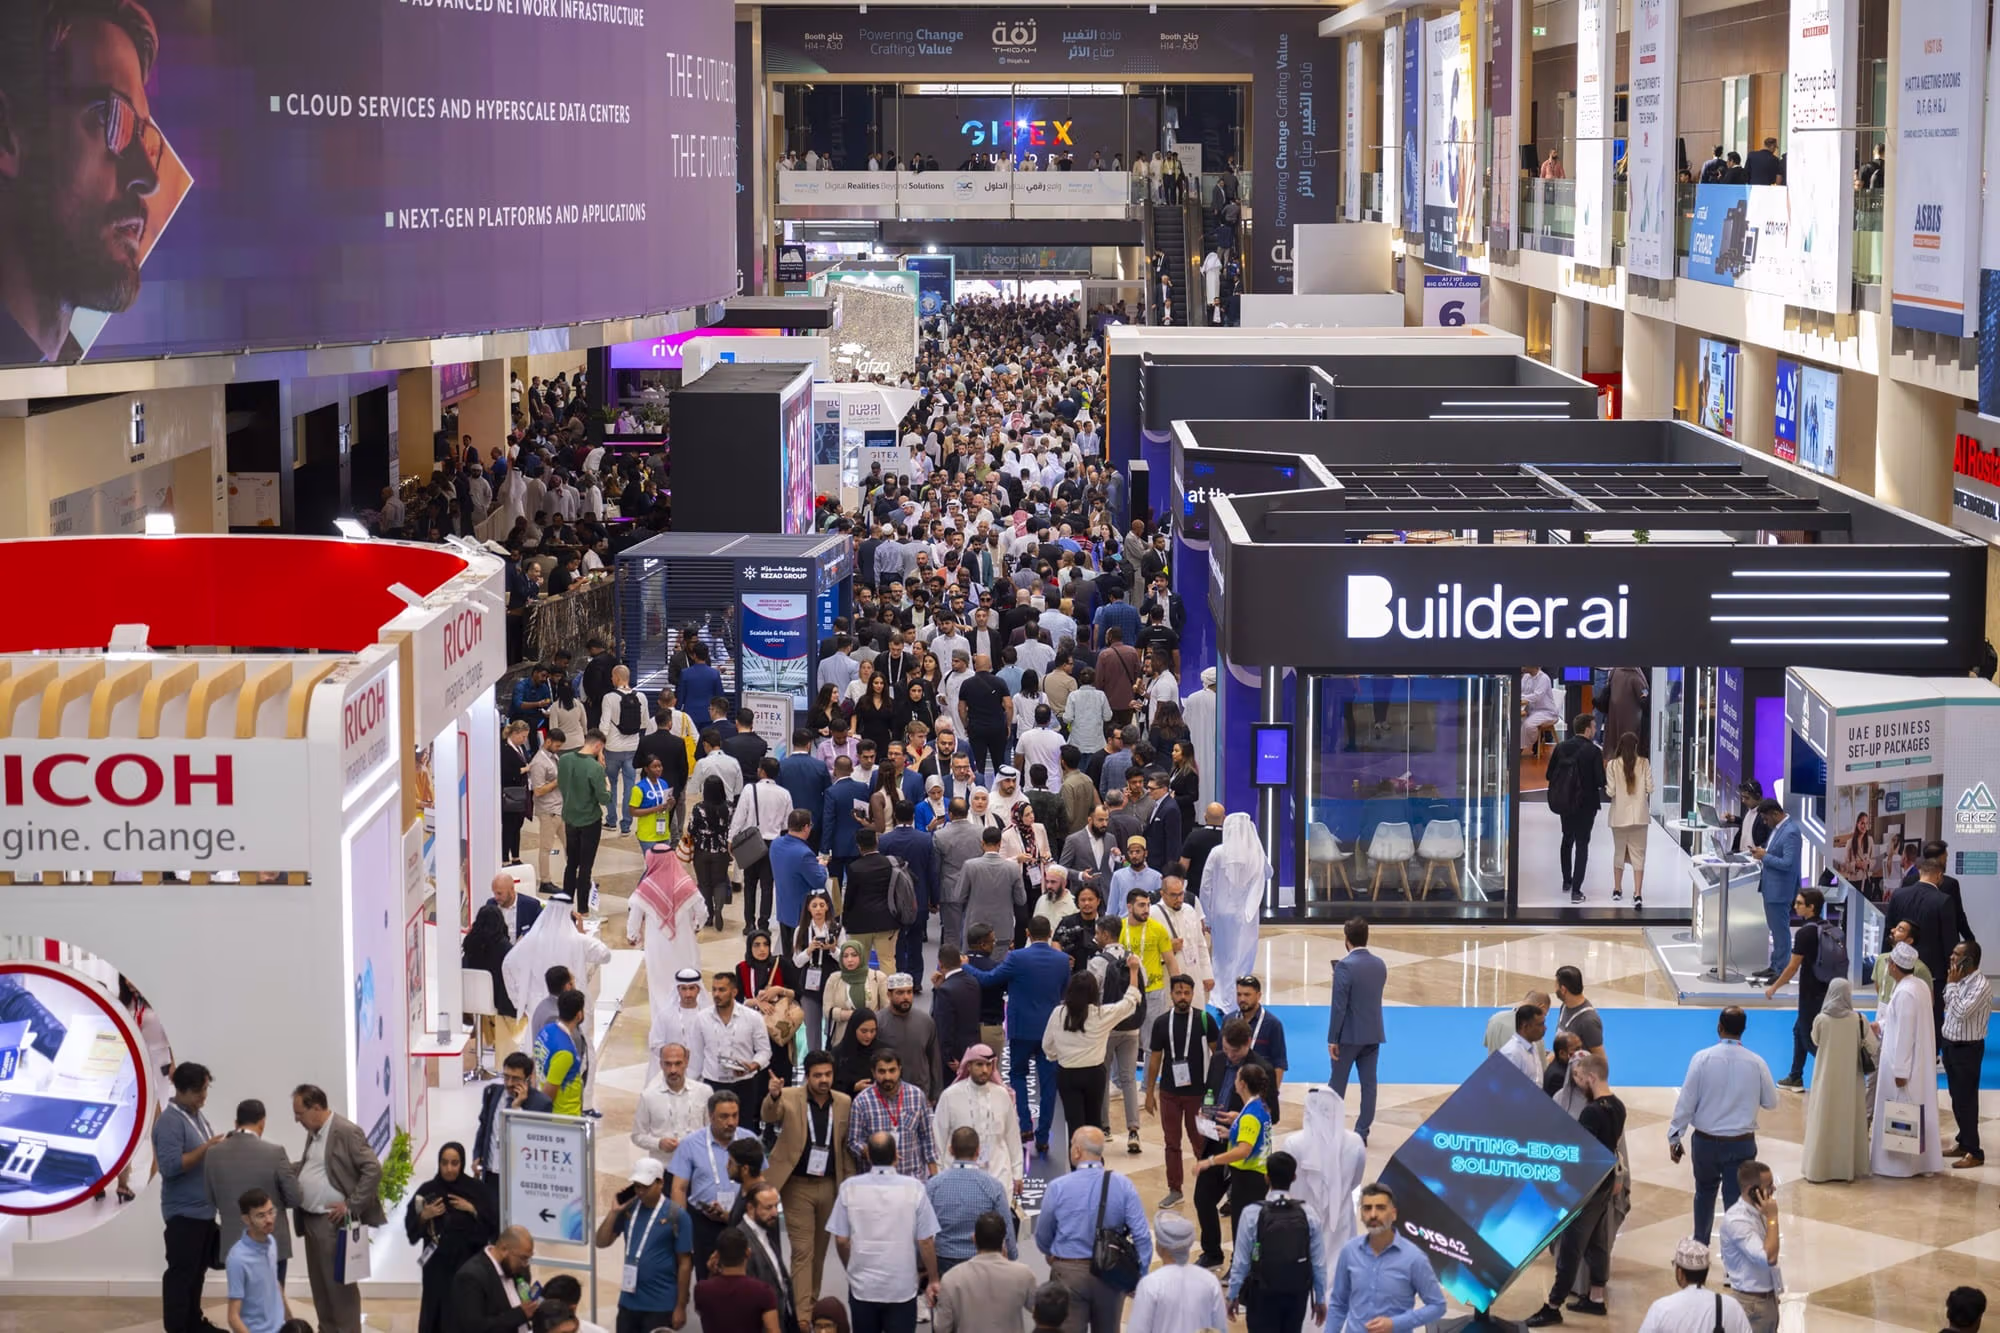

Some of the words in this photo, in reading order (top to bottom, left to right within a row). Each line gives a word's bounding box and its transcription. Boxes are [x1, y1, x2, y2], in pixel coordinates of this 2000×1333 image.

[497, 0, 558, 18] NETWORK
[560, 0, 645, 27] INFRASTRUCTURE
[804, 32, 826, 41] Booth
[827, 33, 844, 43] جناح
[859, 28, 914, 43] Powering
[916, 28, 964, 42] Change
[1062, 28, 1097, 44] التغيير
[1160, 32, 1182, 41] Booth
[1183, 33, 1199, 43] جناح
[870, 43, 916, 57] Crafting
[918, 43, 953, 55] Value
[1068, 45, 1090, 61] الأثر
[1276, 33, 1288, 69] Value
[666, 52, 693, 98] THE
[697, 57, 729, 102] FUTURE
[1920, 74, 1941, 91] MEETING
[1942, 71, 1961, 88] ROOMS
[1275, 72, 1291, 118] Crafting
[286, 93, 352, 117] CLOUD
[358, 96, 436, 118] SERVICES
[440, 98, 472, 119] AND
[475, 99, 556, 122] HYPERSCALE
[559, 102, 588, 122] DATA
[589, 104, 631, 124] CENTERS
[1299, 91, 1317, 137] التغيير
[961, 119, 1073, 146] GITEX
[670, 133, 697, 179] THE
[700, 135, 731, 178] FUTURE
[1275, 120, 1290, 170] Change
[974, 153, 1074, 164] UROPE
[824, 182, 847, 191] Digital
[847, 181, 880, 190] Realities
[908, 181, 944, 190] Solutions
[984, 181, 1008, 193] الحلول
[1026, 182, 1046, 194] رقمي
[1296, 170, 1315, 198] الأثر
[1275, 171, 1289, 228] Powering
[398, 207, 475, 229] NEXT-GEN
[478, 205, 552, 227] PLATFORMS
[555, 205, 580, 225] AND
[581, 203, 646, 224] APPLICATIONS
[1914, 203, 1942, 232] ASBIS
[1438, 300, 1466, 327] 6
[870, 451, 899, 459] GITEX
[1187, 487, 1206, 503] at
[1347, 574, 1629, 640] Builder.ai
[443, 608, 482, 671] RICOH
[344, 678, 386, 749] RICOH
[753, 711, 782, 721] GITEX
[1848, 726, 1870, 741] UAE
[1875, 719, 1931, 738] BUSINESS
[1848, 741, 1882, 759] SET-UP
[1884, 736, 1930, 755] PACKAGES
[1955, 811, 1997, 823] rakez
[3, 820, 91, 860] gine.
[102, 820, 246, 860] change.
[526, 1132, 553, 1143] GUIDES
[555, 1136, 566, 1144] ON
[1432, 1132, 1580, 1163] CUTTING-EDGE
[520, 1146, 573, 1166] GITEX
[525, 1162, 573, 1174] GLOBAL
[1451, 1155, 1561, 1182] SOLUTIONS
[520, 1180, 548, 1190] GUIDED
[550, 1184, 574, 1193] TOURS
[524, 1189, 550, 1198] MEETING
[1403, 1220, 1469, 1256] core42
